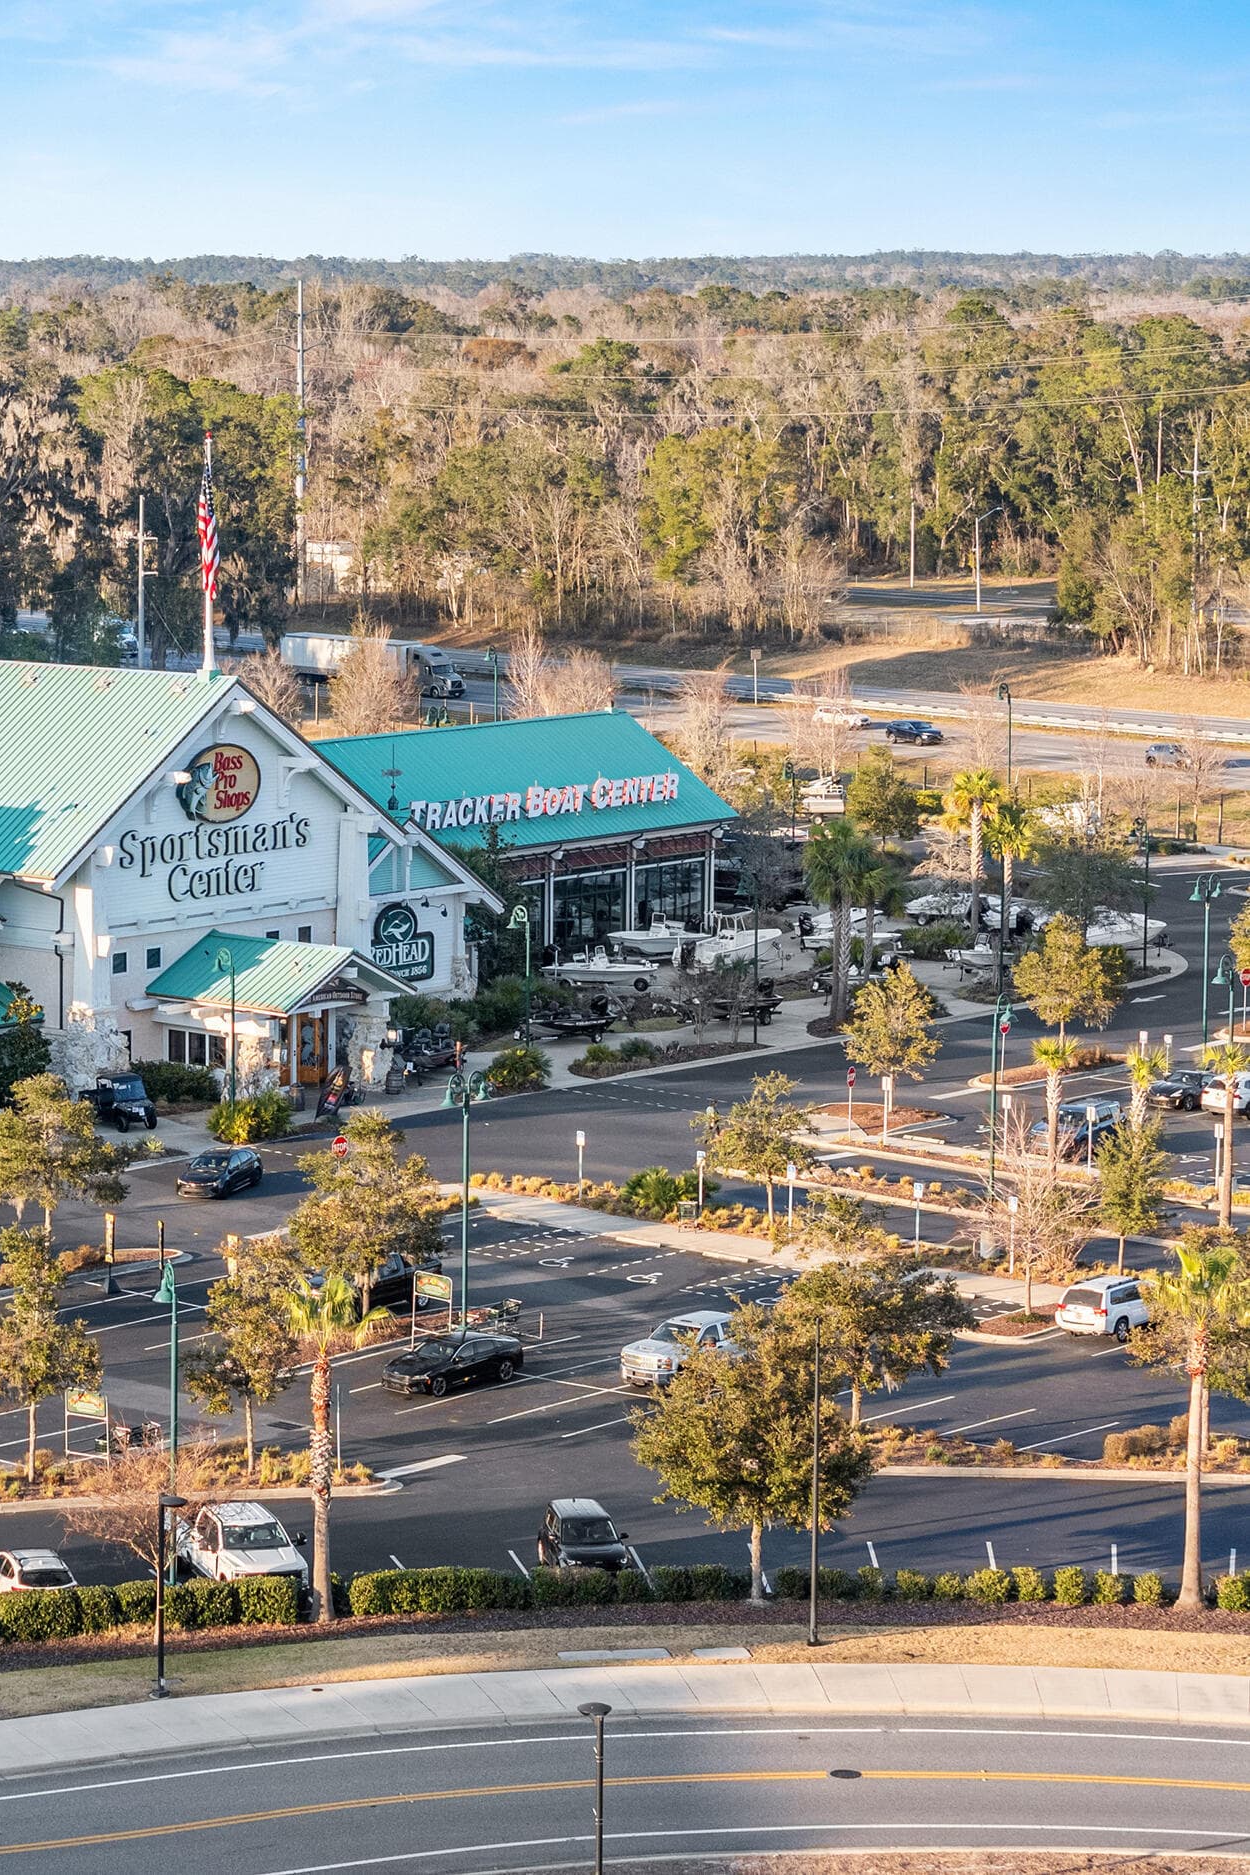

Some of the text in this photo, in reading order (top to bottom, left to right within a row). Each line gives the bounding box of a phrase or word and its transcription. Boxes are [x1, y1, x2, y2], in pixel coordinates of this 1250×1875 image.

[214, 752, 243, 771] Bass
[214, 771, 237, 790] Pro
[214, 790, 251, 811] Shops
[410, 773, 680, 830] TRACKER BOAT CENTER
[119, 812, 311, 877] Sportsman's
[168, 859, 265, 902] Center
[411, 965, 427, 976] 1856
